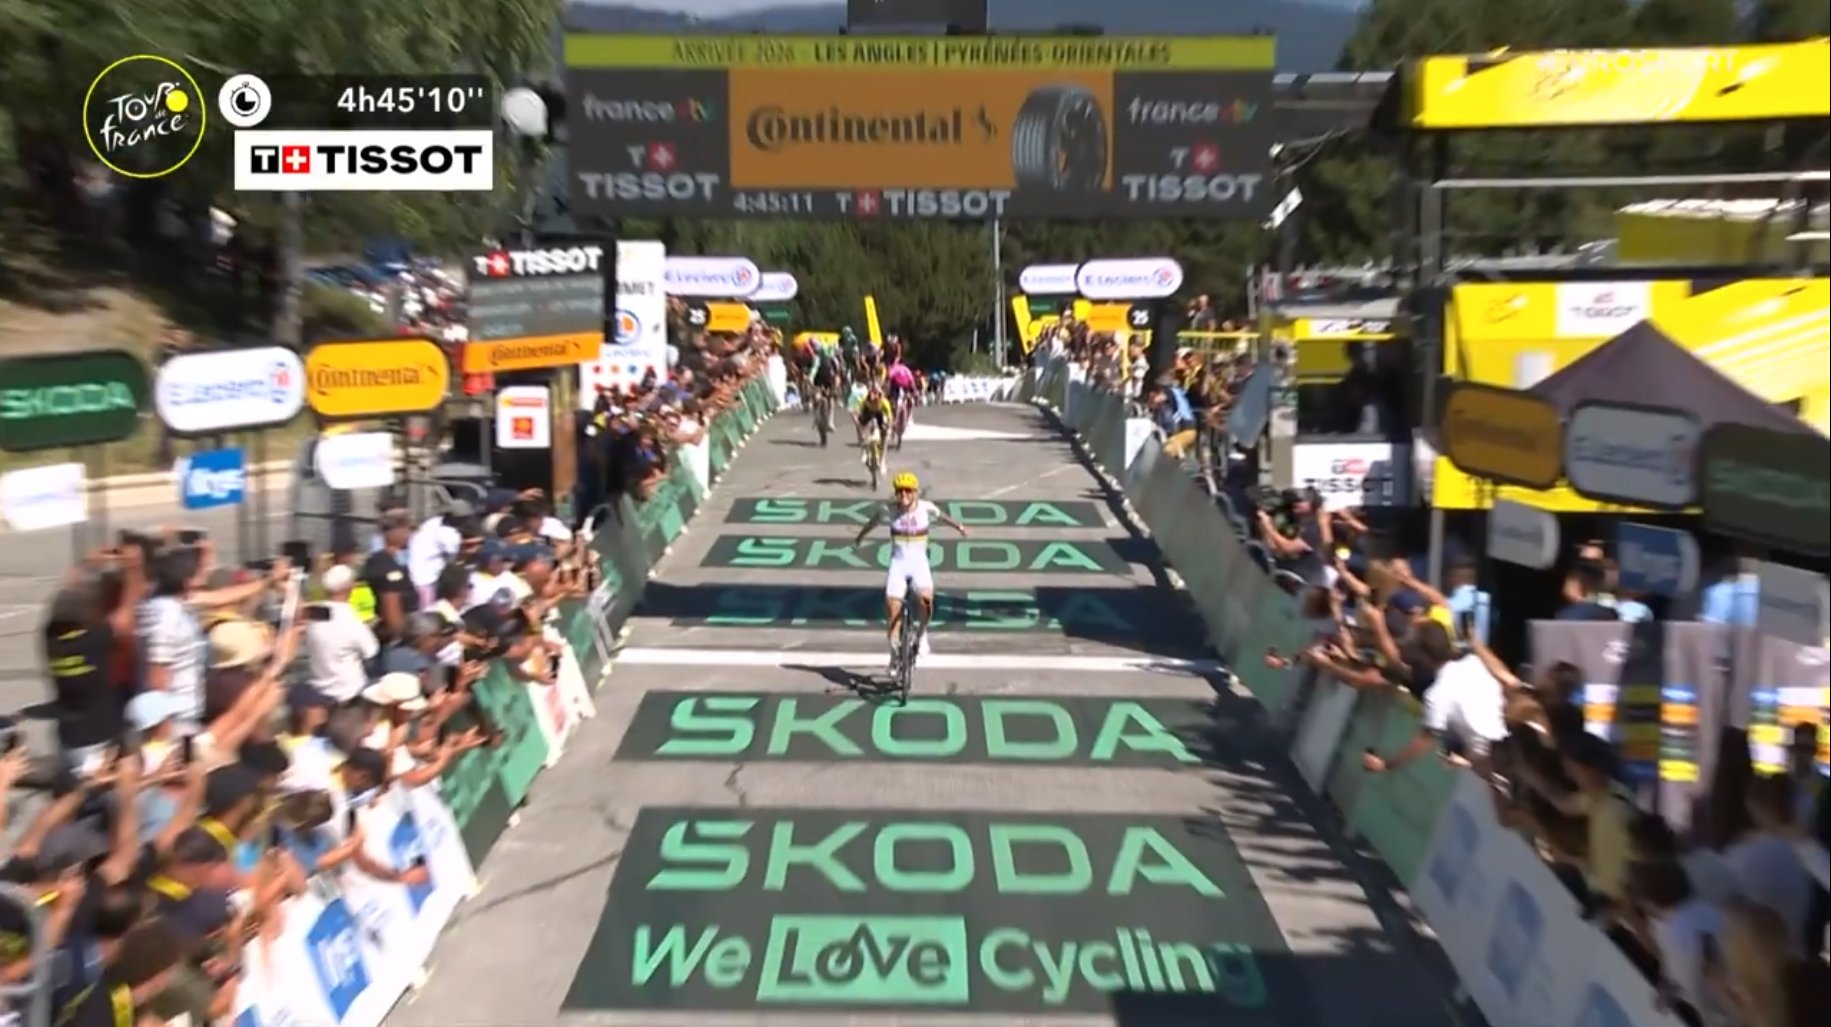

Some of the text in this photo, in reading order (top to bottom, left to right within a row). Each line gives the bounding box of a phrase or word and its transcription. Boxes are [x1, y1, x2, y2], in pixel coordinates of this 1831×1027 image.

[814, 40, 847, 63] LES
[853, 40, 928, 63] ANGLES
[746, 105, 962, 152] Continental
[577, 173, 720, 200] TISSOT
[1122, 175, 1262, 202] TISSOT
[733, 192, 814, 214] 4:45:11
[884, 190, 1011, 217] TISSOT
[508, 246, 604, 277] TISSOT
[632, 922, 752, 989] We
[979, 924, 1267, 1005] Cycling
